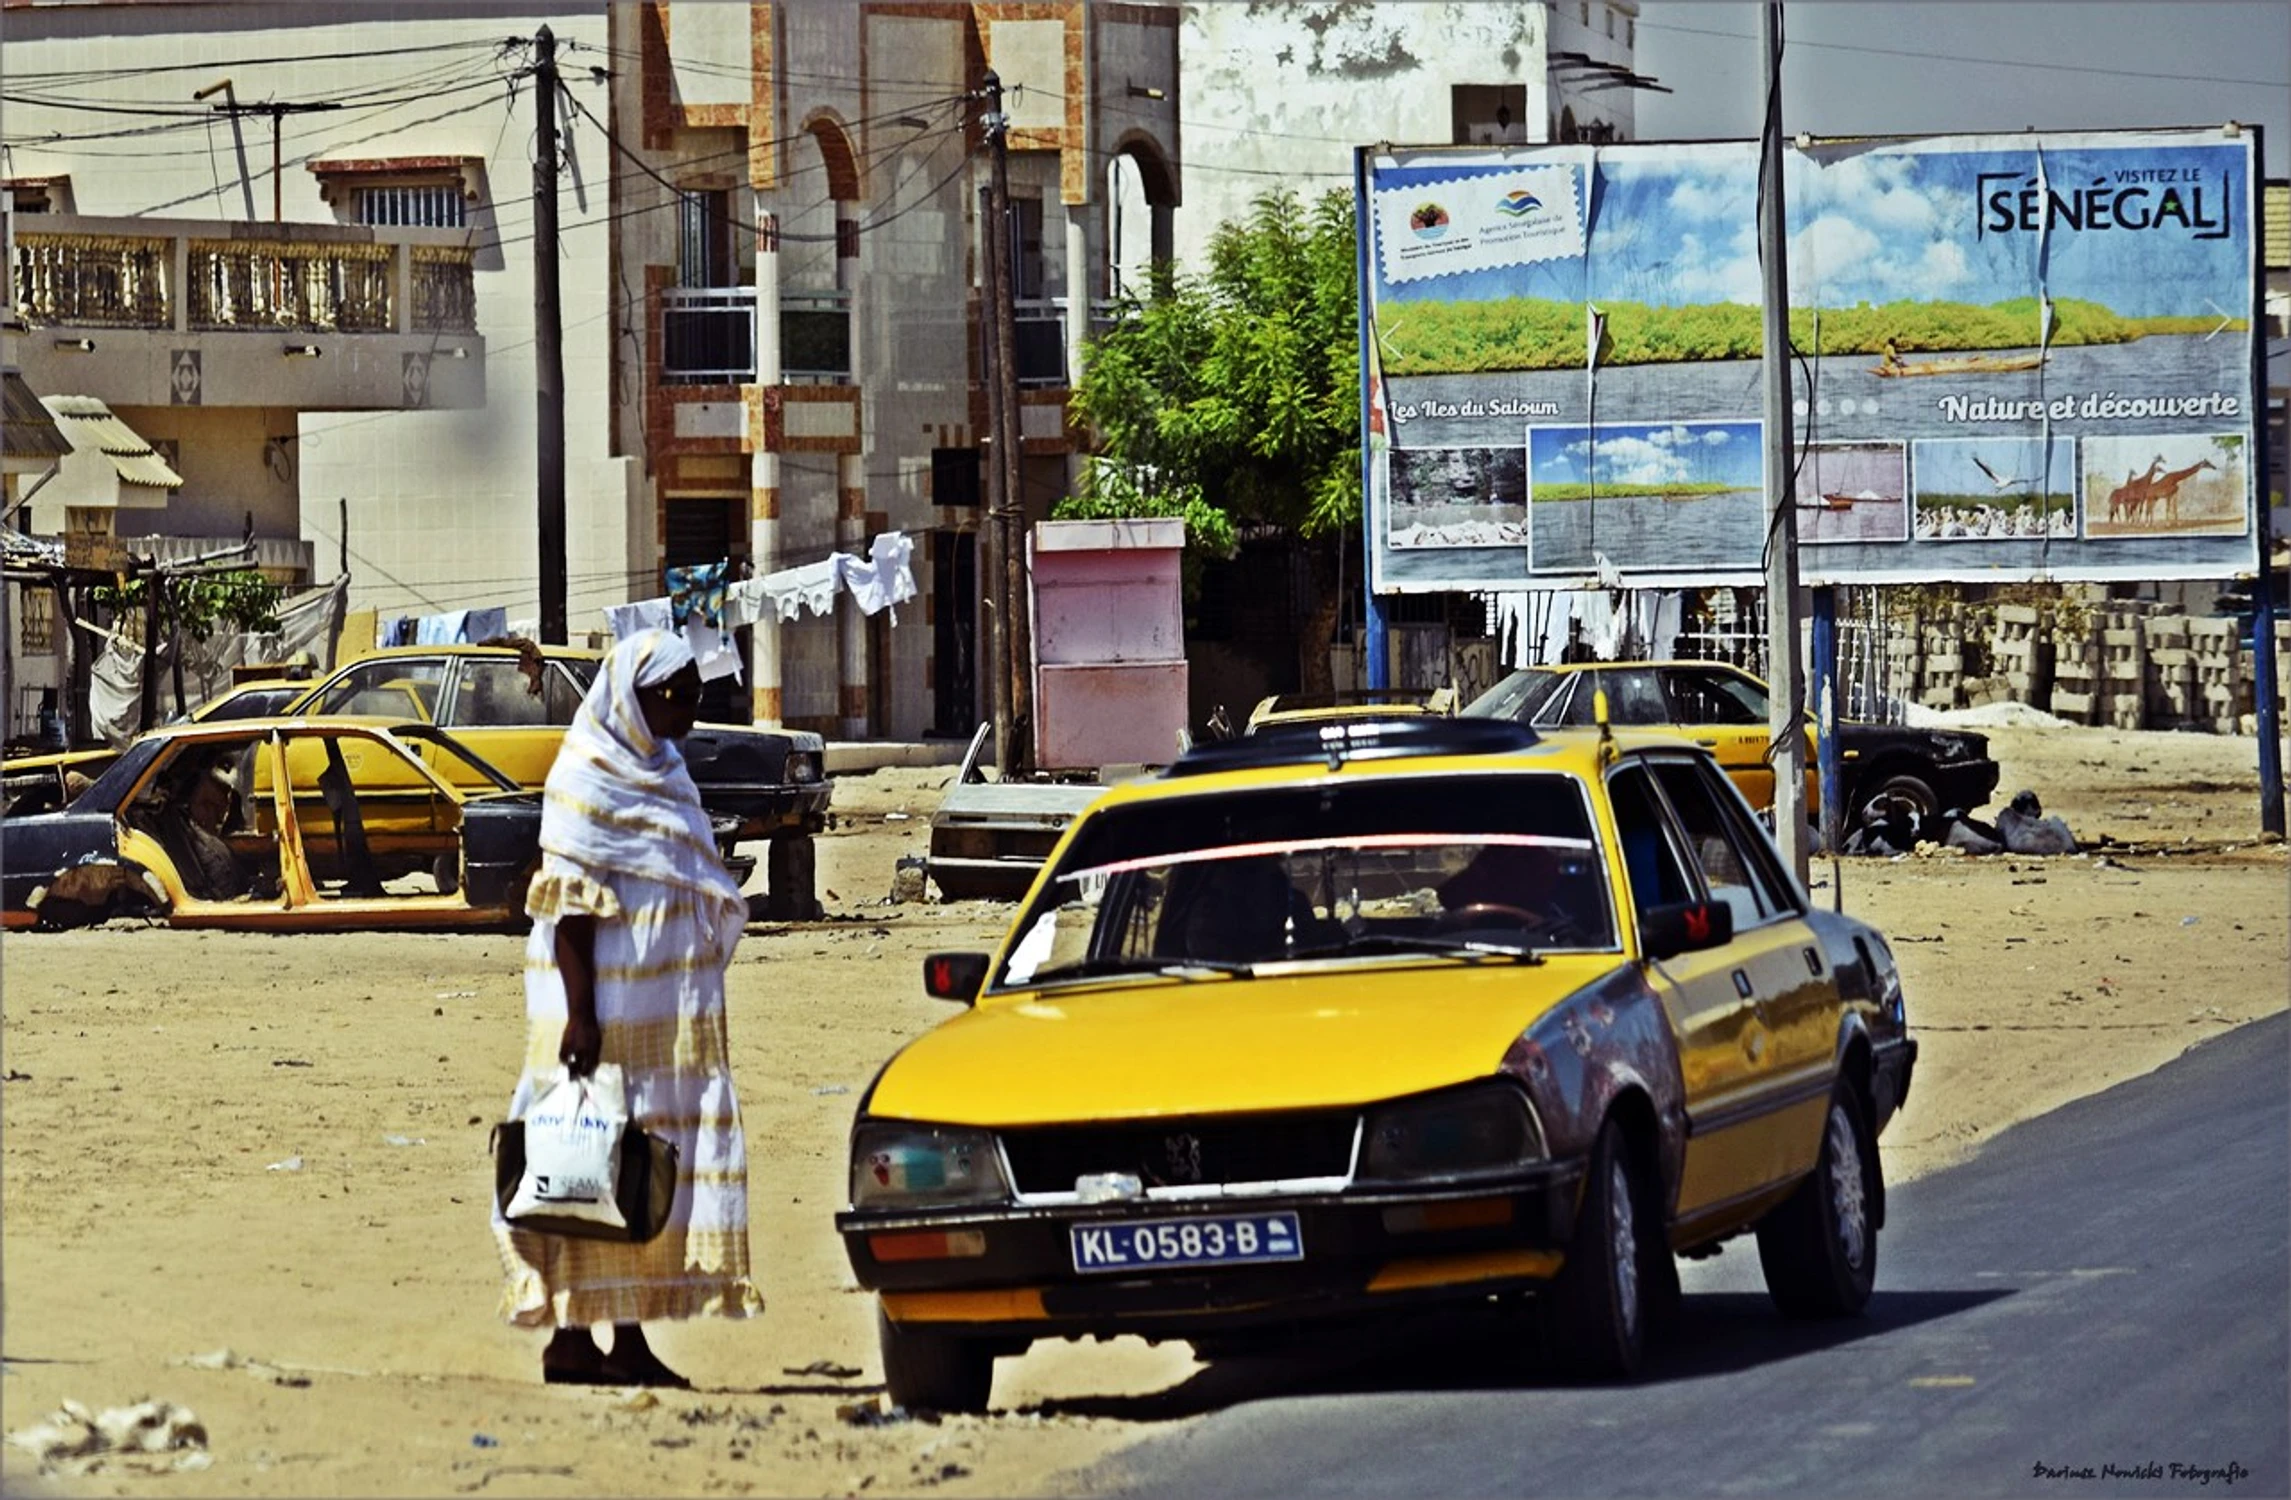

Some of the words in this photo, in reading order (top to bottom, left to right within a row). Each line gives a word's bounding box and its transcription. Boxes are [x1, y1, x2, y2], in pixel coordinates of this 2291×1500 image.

[2114, 169, 2176, 183] VISITEZ
[2183, 168, 2200, 182] LE
[1989, 176, 2217, 233] SÉNÉGAL
[1389, 400, 1417, 423] Les
[1461, 399, 1484, 417] du
[1489, 398, 1559, 417] Saloum
[1938, 395, 2045, 421] Nature
[2051, 396, 2076, 421] et
[2081, 391, 2239, 419] découverte
